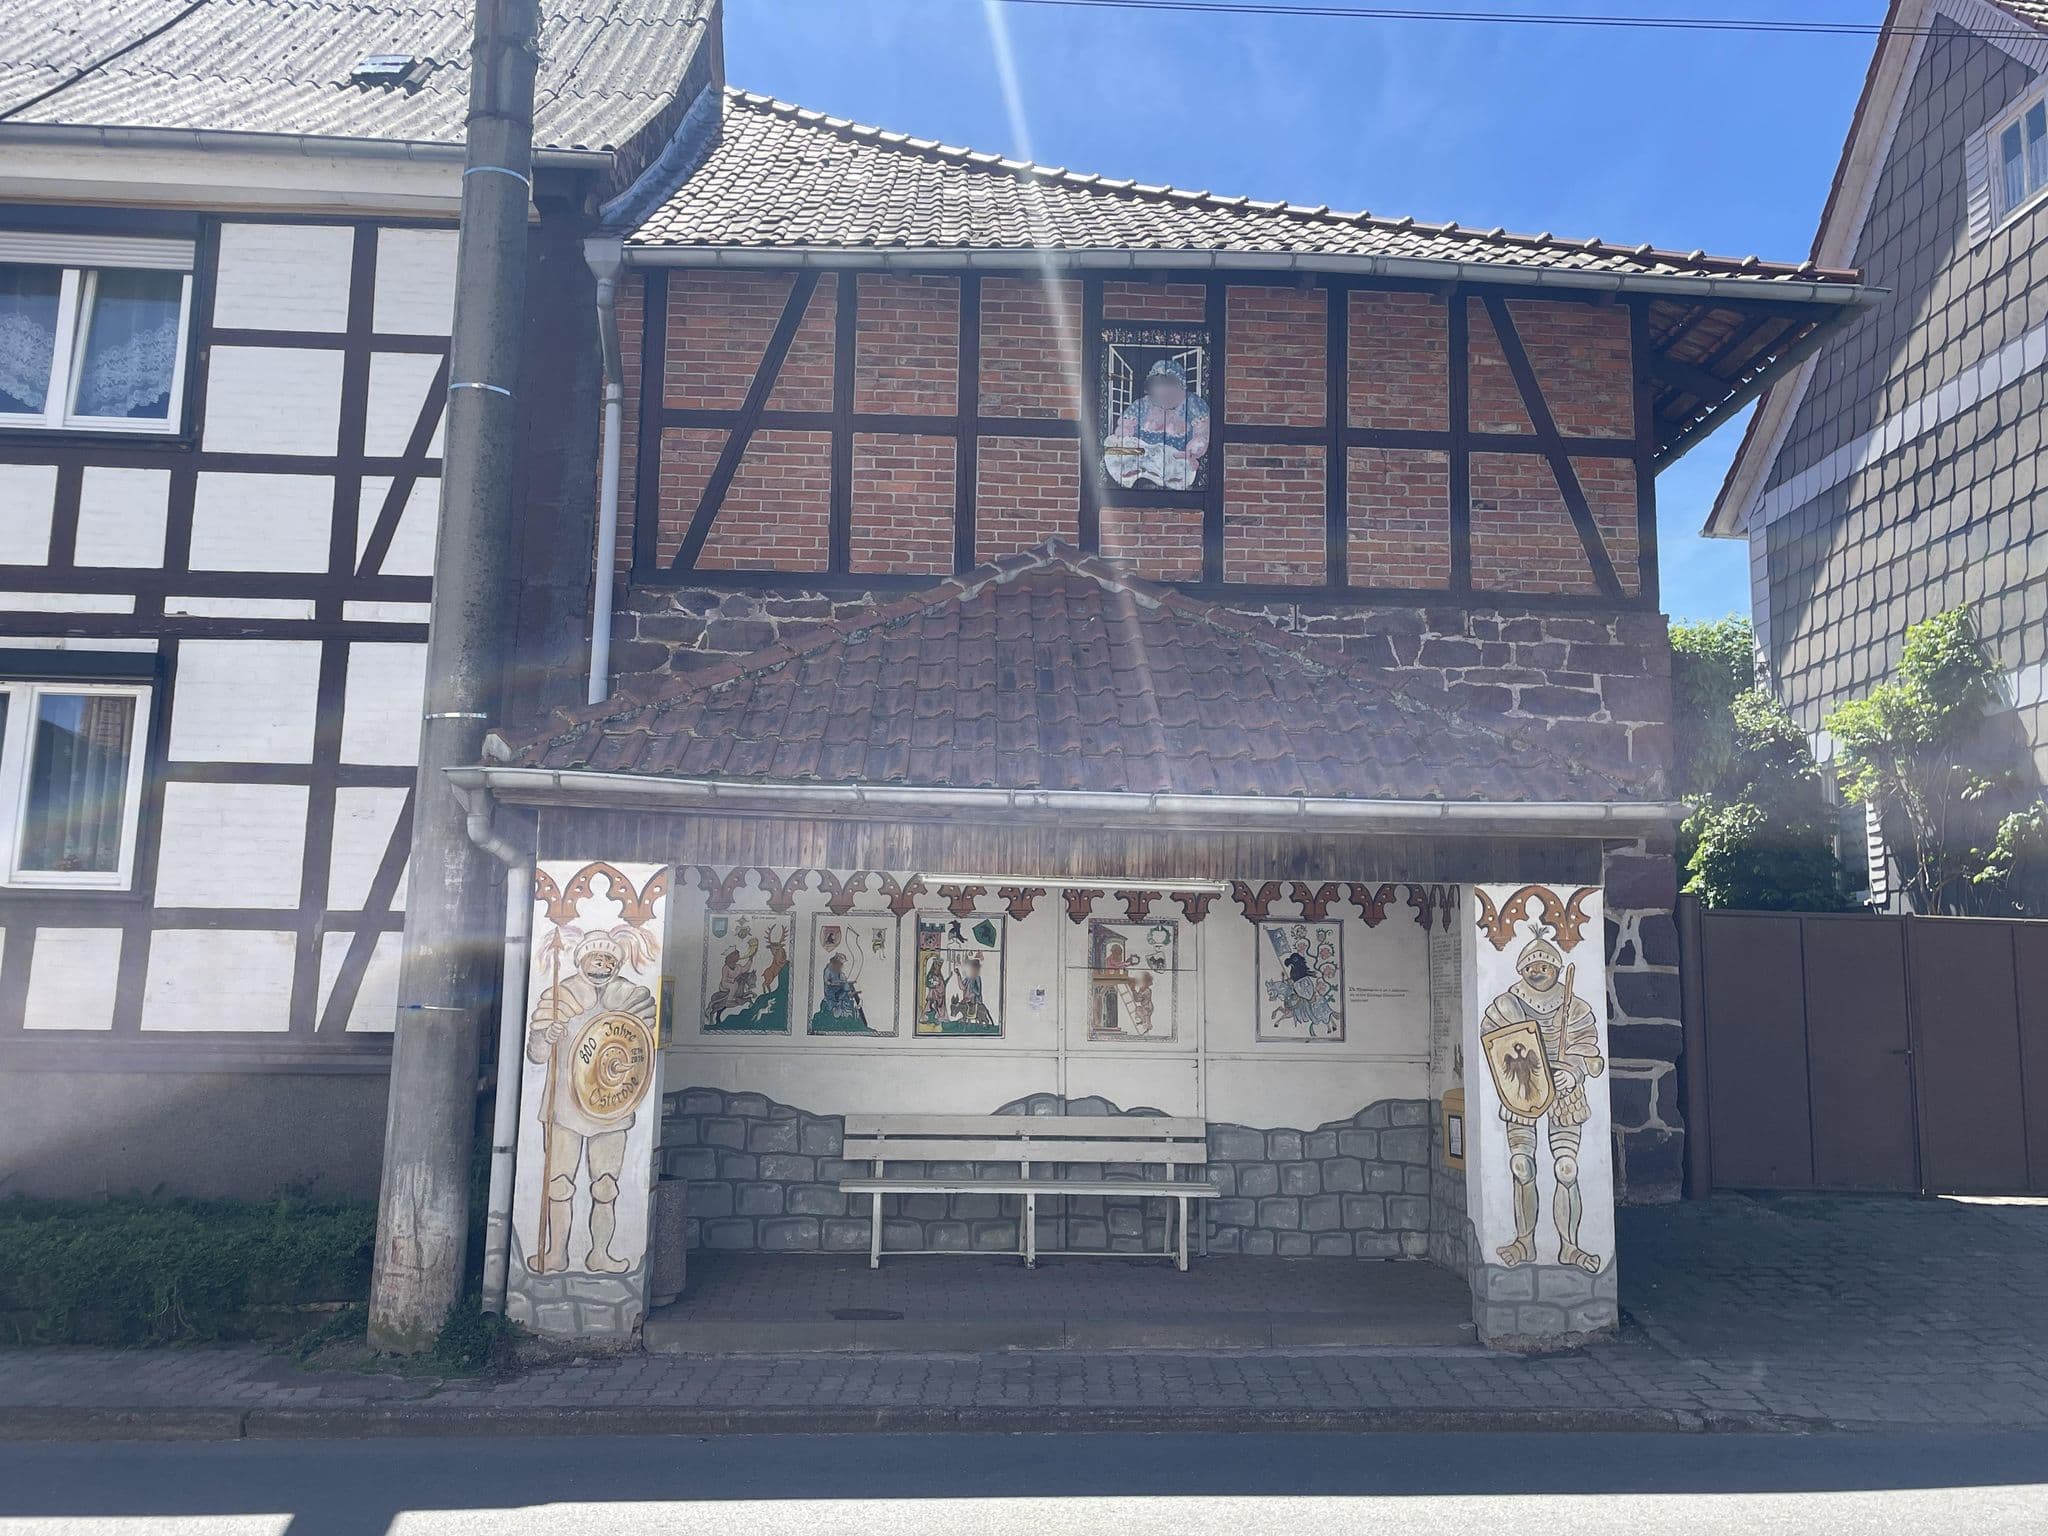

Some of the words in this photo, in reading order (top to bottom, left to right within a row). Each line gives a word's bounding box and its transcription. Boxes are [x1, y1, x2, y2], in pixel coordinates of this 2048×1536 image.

[579, 1037, 597, 1064] 800
[603, 1021, 637, 1042] Jahre
[589, 1075, 639, 1109] Osterode
